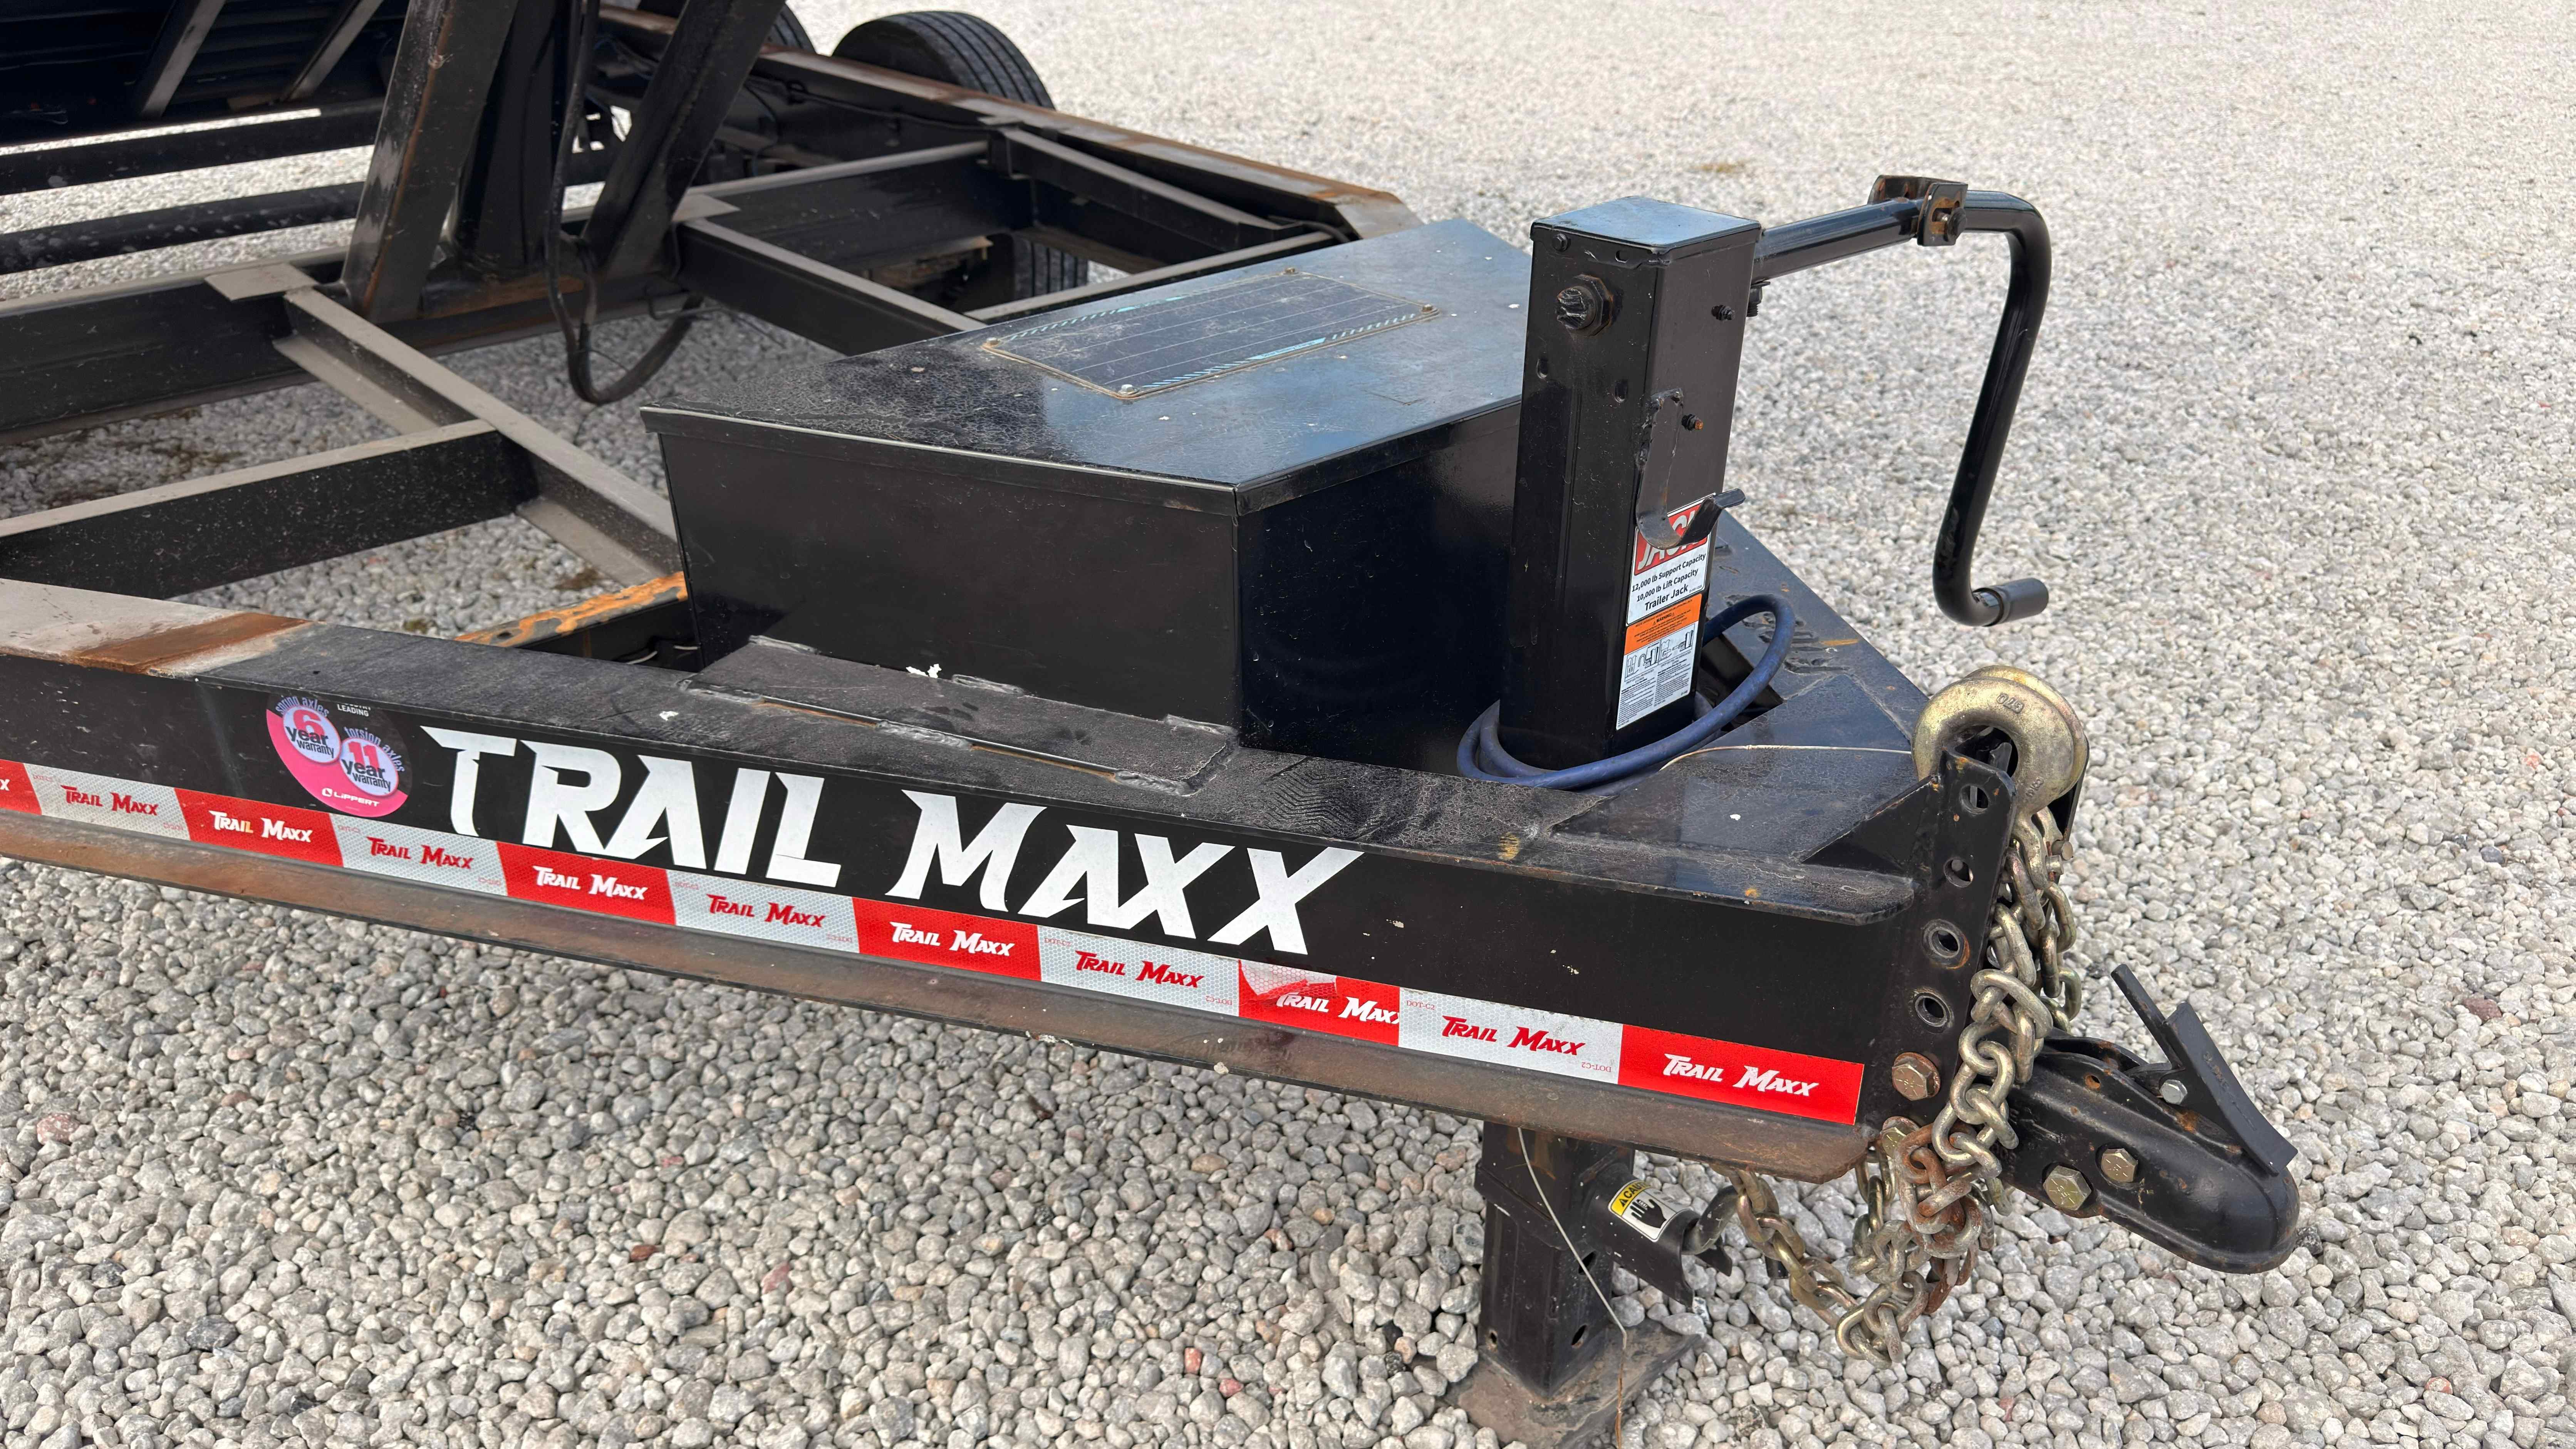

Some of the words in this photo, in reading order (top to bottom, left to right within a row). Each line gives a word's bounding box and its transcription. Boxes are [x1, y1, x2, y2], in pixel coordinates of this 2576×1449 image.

[1632, 578, 1651, 592] 12,000
[1659, 564, 1681, 579] Support
[1682, 553, 1706, 568] Capacity
[1637, 588, 1655, 602] 10,000
[1663, 580, 1672, 589] Lift
[1674, 569, 1698, 584] Capacity
[1645, 594, 1670, 611] Trailer
[1671, 584, 1689, 598] Jack
[275, 696, 299, 715] spring
[302, 697, 329, 717] axles
[293, 709, 325, 734] 6
[337, 704, 369, 716] LEADING
[285, 726, 329, 743] year
[297, 740, 334, 758] warranty
[344, 726, 381, 746] torsion
[382, 745, 405, 772] axles
[341, 759, 385, 778] year
[348, 741, 379, 769] 11
[353, 773, 391, 792] warranty
[62, 785, 102, 807] TRAIL
[111, 793, 158, 816] MAXX
[209, 811, 253, 834] TRAIL
[261, 818, 312, 843] MAXX
[420, 726, 841, 888] TRAIL
[885, 790, 1364, 955] MAXX
[367, 837, 410, 860] TRAIL
[420, 845, 473, 870] MAXX
[533, 866, 580, 890] TRAIL
[589, 874, 648, 900] MAXX
[707, 894, 754, 917] TRAIL
[765, 903, 825, 927] MAXX
[890, 922, 941, 946] TRAIL
[949, 930, 1015, 956] MAXX
[1075, 951, 1125, 976] TRAIL
[1135, 961, 1204, 988] MAXX
[1206, 996, 1232, 1005] DOT-C2
[1406, 1000, 1435, 1010] DOT-C2
[1442, 1016, 1497, 1042] TRAIL
[1507, 1027, 1585, 1056] MAXX
[1581, 1062, 1611, 1072] DOT-C2
[1663, 1054, 1724, 1082] TRAIL
[1733, 1066, 1819, 1097] MAXX
